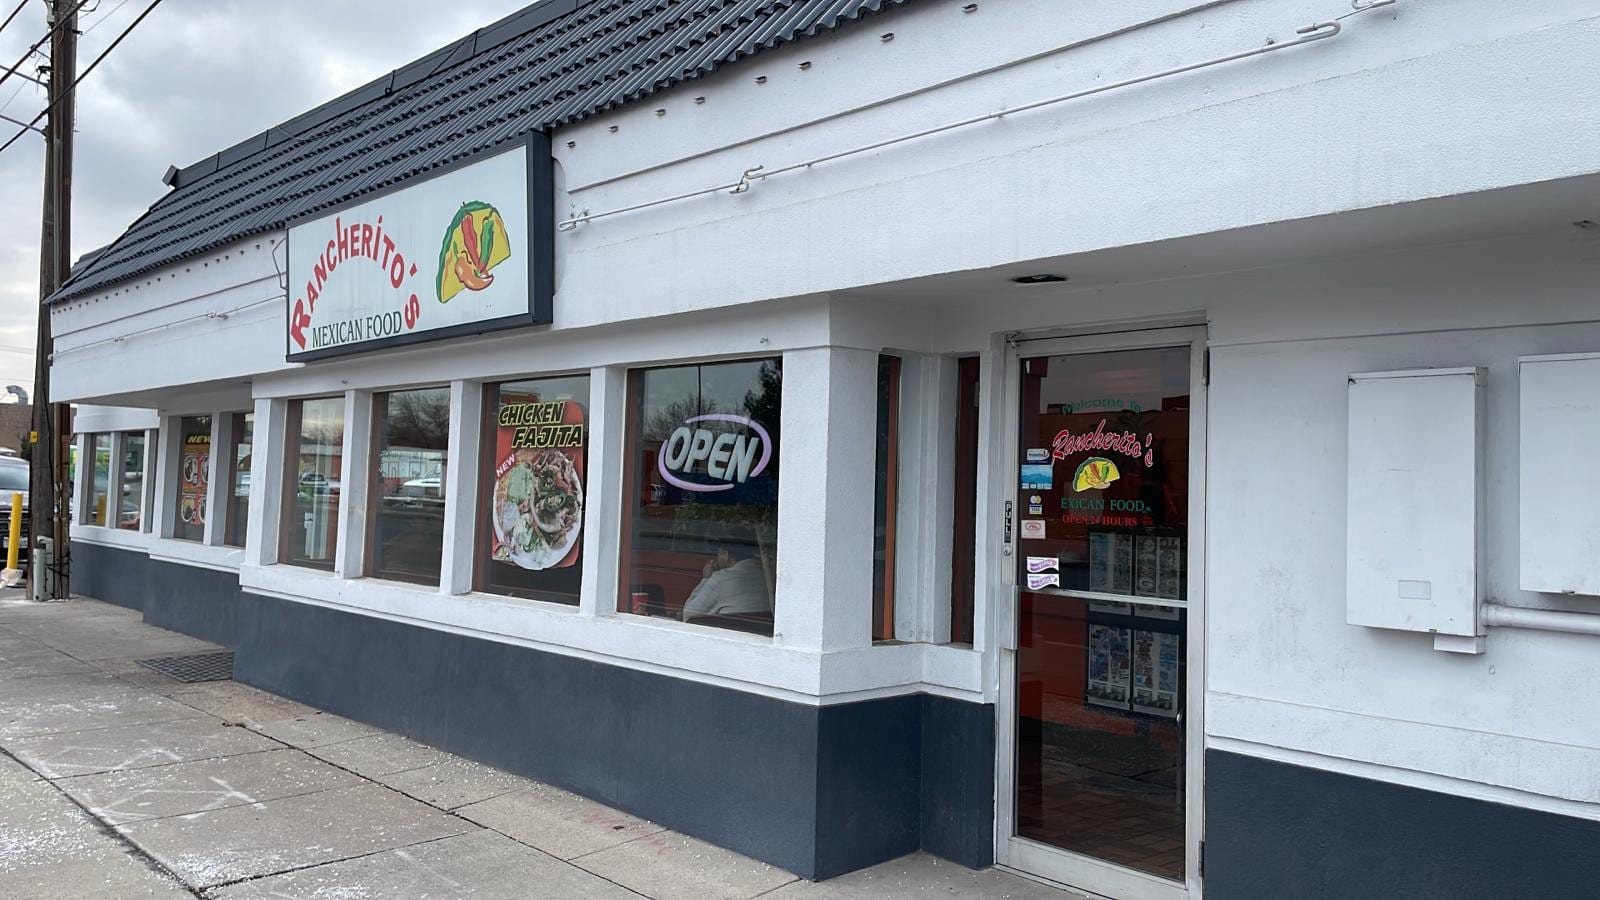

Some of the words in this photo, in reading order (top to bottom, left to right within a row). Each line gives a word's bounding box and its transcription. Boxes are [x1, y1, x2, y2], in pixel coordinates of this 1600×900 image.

[312, 318, 364, 348] MEXICAN
[366, 311, 401, 338] FOOD
[498, 401, 565, 425] CHICKEN
[511, 424, 583, 448] FAJITA
[496, 453, 516, 477] NEW
[665, 426, 759, 483] OPEN
[1103, 516, 1137, 526] HOURS
